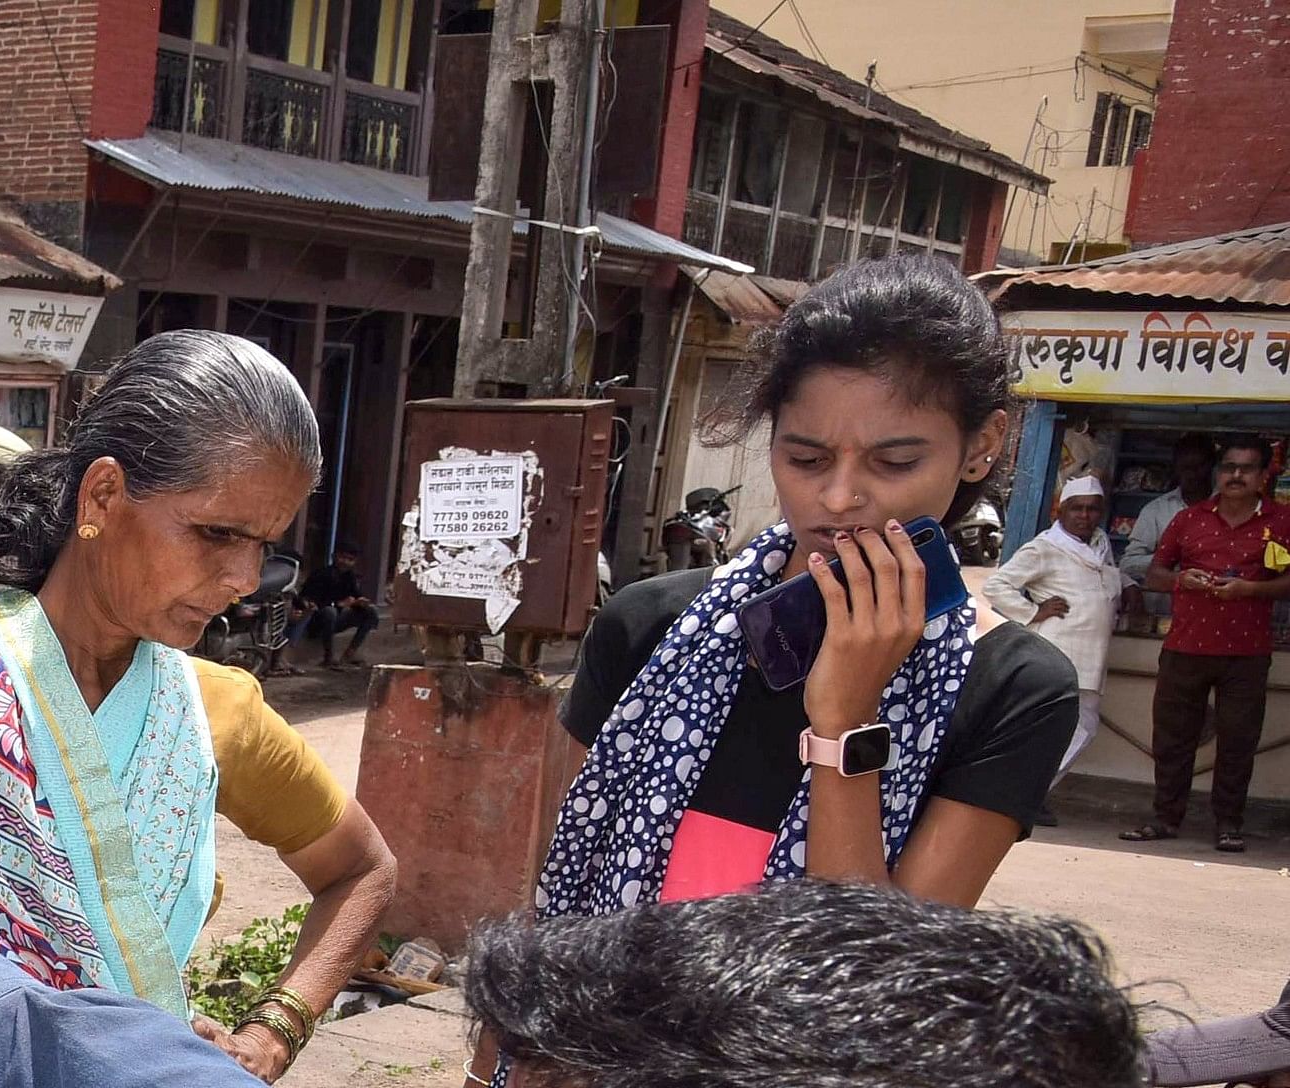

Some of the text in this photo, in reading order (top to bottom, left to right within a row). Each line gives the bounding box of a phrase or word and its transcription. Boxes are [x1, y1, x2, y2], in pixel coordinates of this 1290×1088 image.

[8, 302, 92, 339] न्यू बॉम्बे टेलर्स
[1137, 310, 1255, 375] विविध
[432, 510, 509, 522] 77739 09620
[432, 522, 509, 533] 77580 26262
